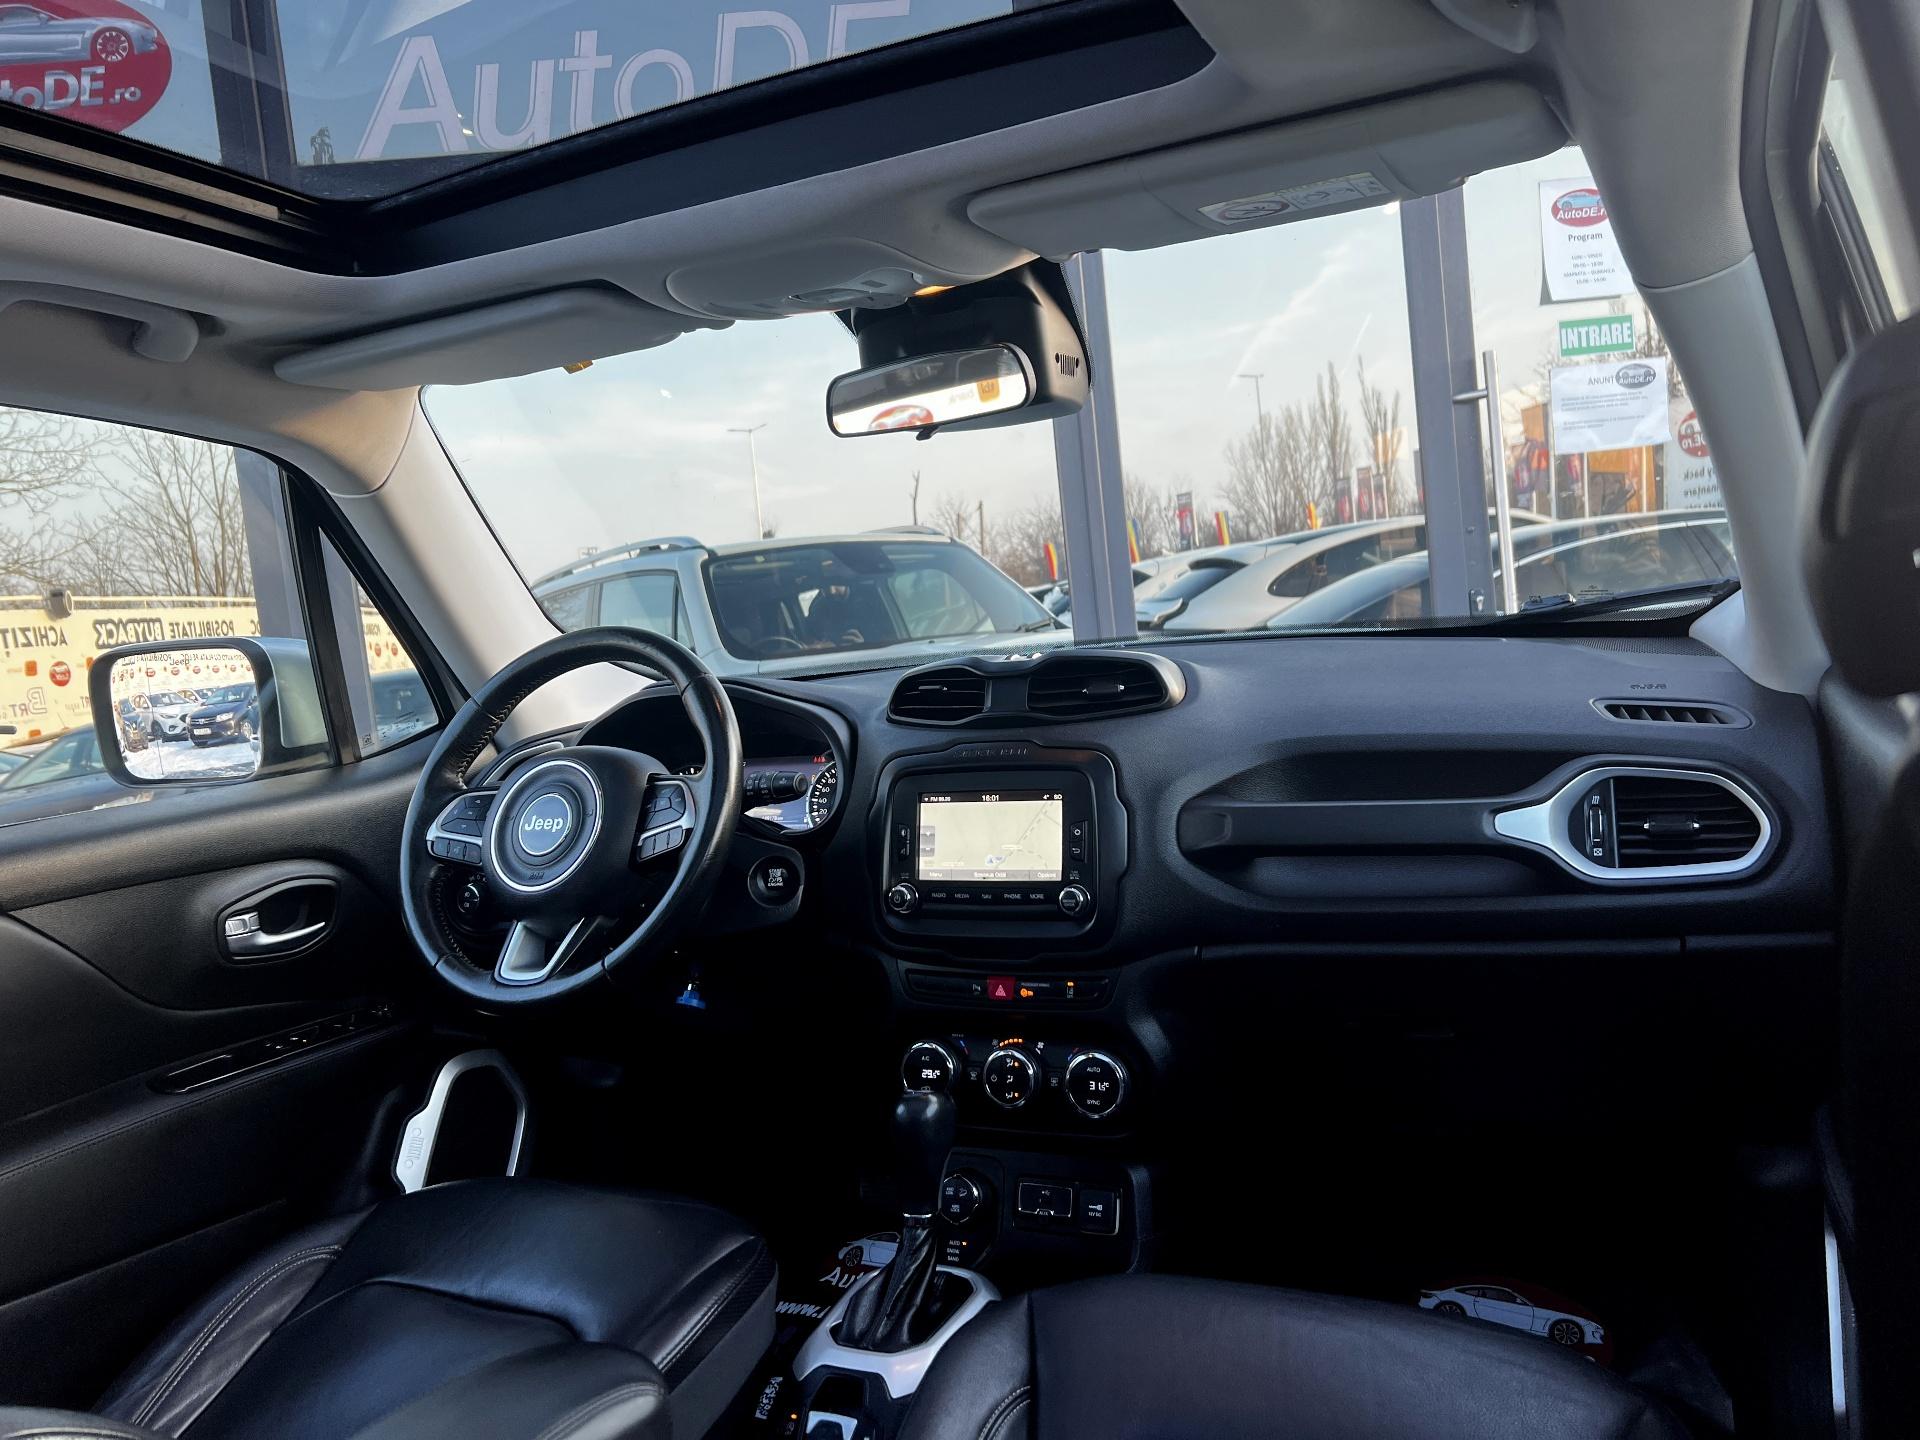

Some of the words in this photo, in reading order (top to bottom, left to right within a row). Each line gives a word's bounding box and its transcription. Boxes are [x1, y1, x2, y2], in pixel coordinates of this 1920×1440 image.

[1557, 206, 1607, 219] AutoDE.r
[1567, 232, 1603, 243] Program
[1561, 322, 1632, 350] INTRARE
[525, 815, 563, 832] Jeep
[818, 1266, 865, 1289] Au
